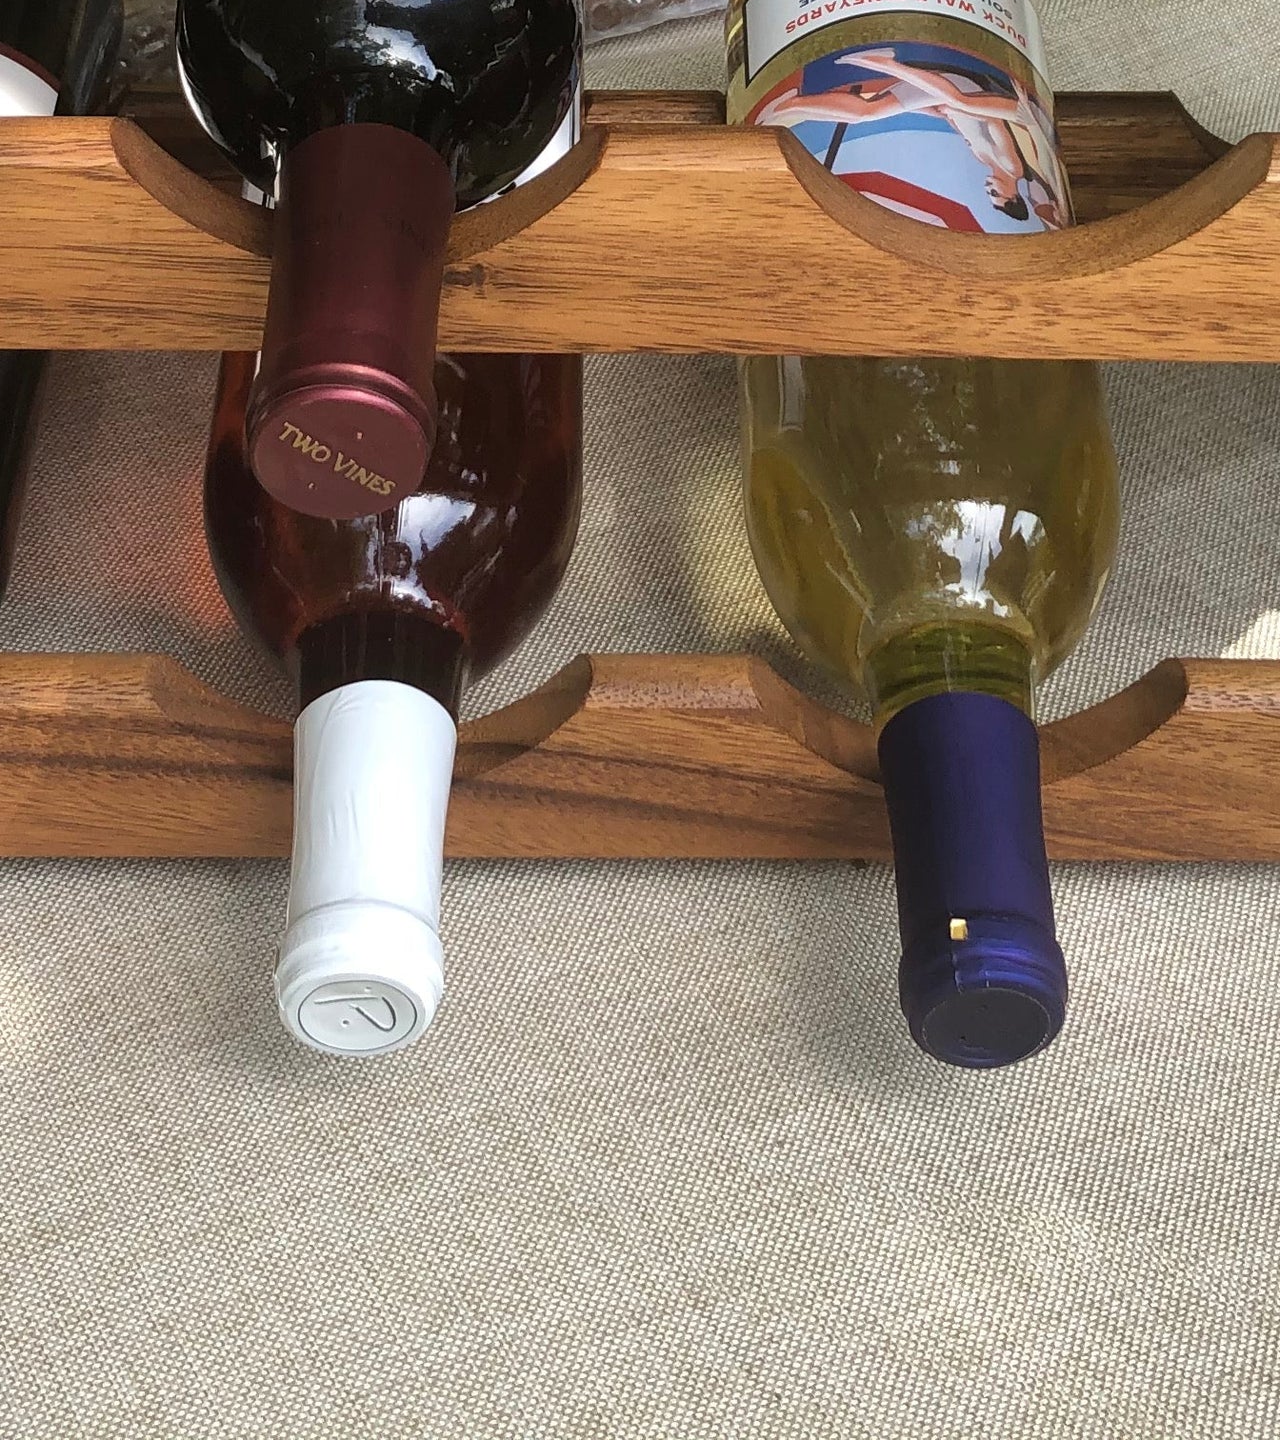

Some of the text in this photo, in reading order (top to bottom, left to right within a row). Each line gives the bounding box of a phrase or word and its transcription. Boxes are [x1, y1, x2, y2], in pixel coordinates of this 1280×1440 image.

[982, 8, 1027, 48] DUCK
[278, 421, 397, 496] TWO VINES
